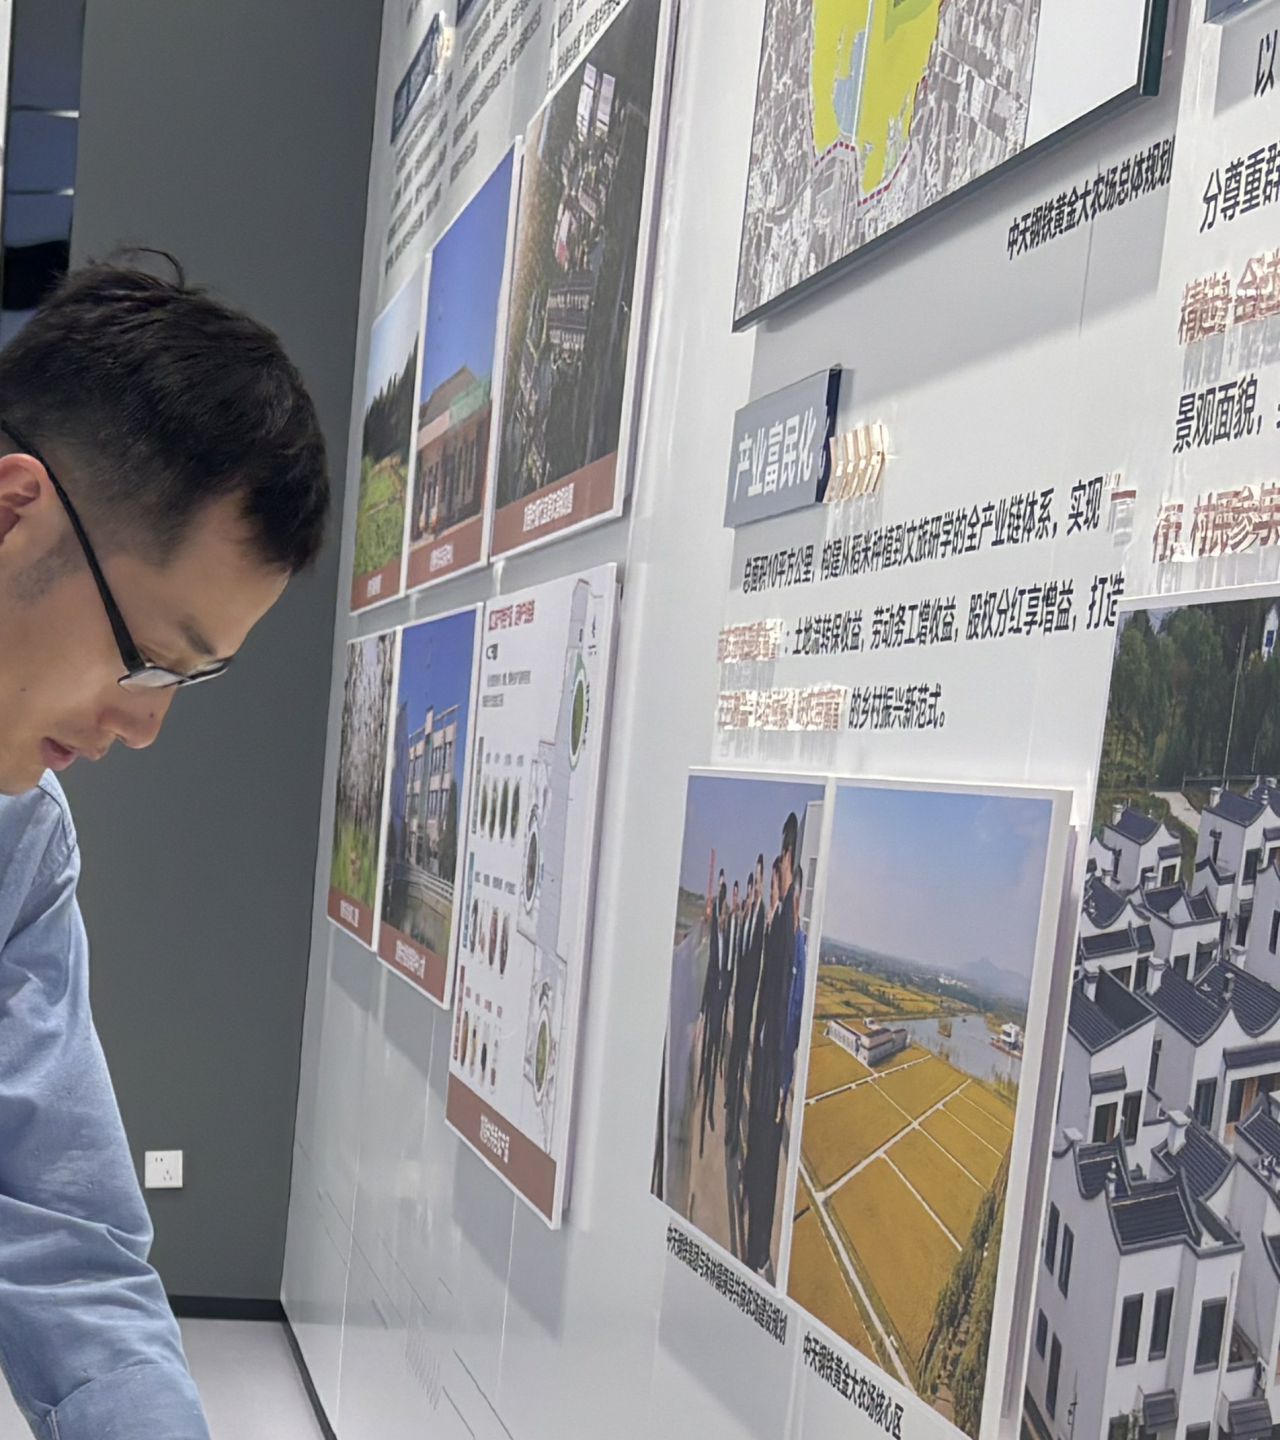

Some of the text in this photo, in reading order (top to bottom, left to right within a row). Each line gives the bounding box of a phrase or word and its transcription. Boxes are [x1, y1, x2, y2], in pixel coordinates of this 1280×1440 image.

[732, 406, 817, 503] 产业富民化
